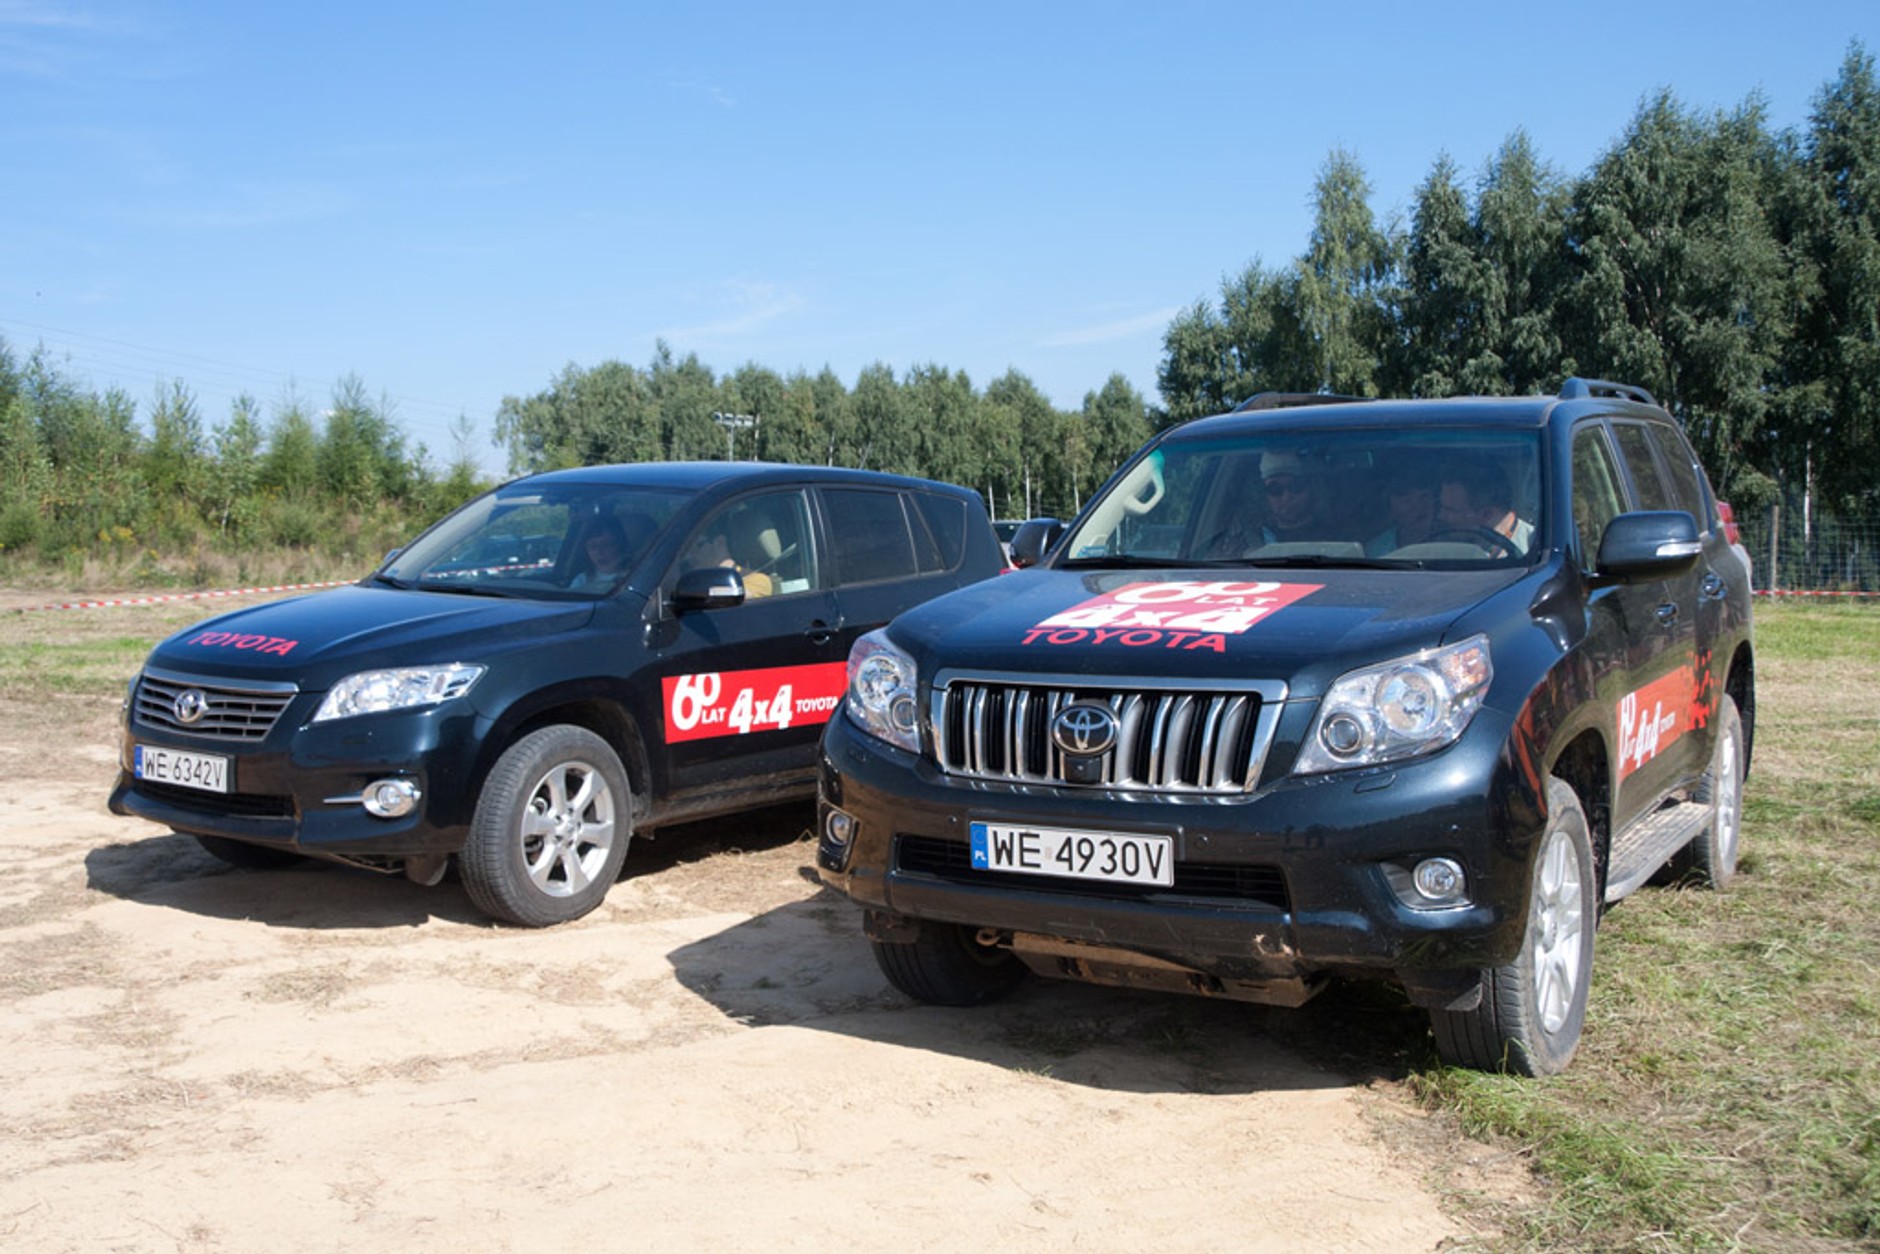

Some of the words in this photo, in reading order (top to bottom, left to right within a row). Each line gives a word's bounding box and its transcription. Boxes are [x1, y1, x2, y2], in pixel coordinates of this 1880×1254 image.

[1194, 596, 1278, 606] LAT
[188, 632, 299, 656] TOYOTA
[1021, 629, 1226, 653] TOYOTA
[672, 673, 721, 730] 60
[701, 708, 727, 724] LAT
[145, 751, 167, 779] WE
[173, 756, 223, 788] 6342V
[975, 850, 986, 861] PL
[993, 830, 1041, 869] WE
[1055, 836, 1164, 879] 4930V
